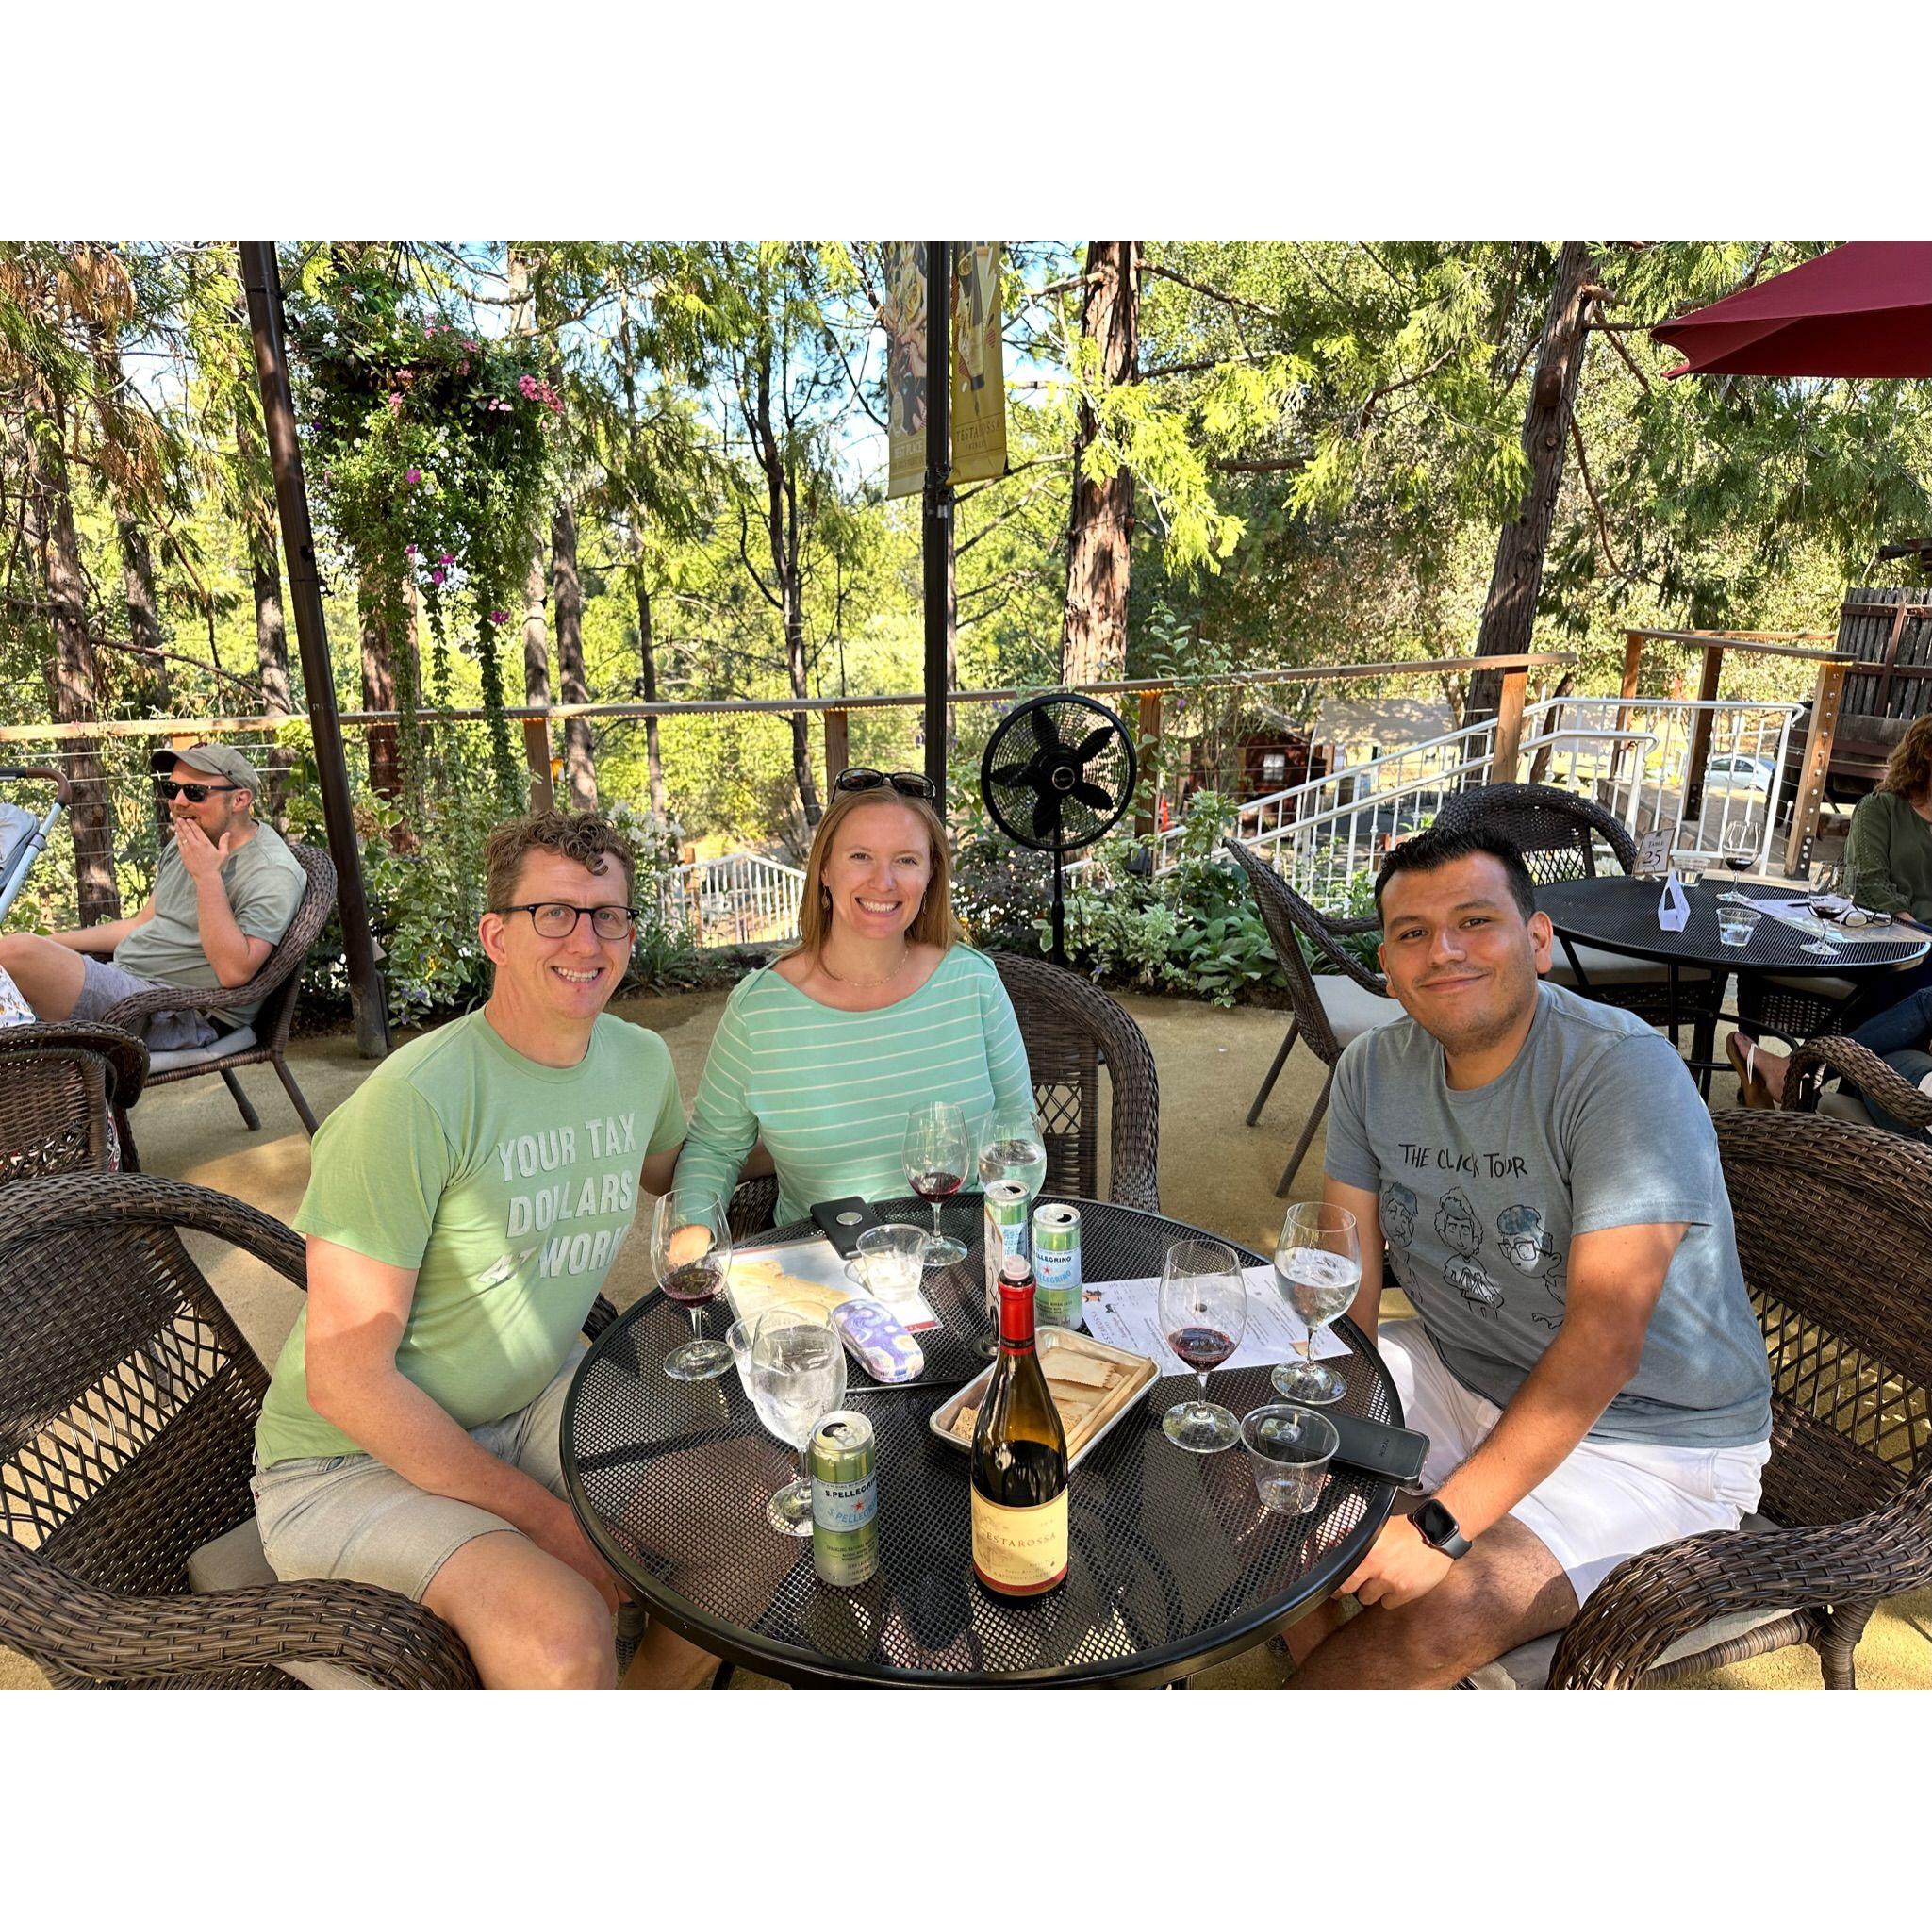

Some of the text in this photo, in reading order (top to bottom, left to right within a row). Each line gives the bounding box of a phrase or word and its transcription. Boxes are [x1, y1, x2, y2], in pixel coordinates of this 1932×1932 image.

[1642, 849, 1663, 865] 25
[498, 1112, 636, 1182] YOUR TAX
[1398, 1143, 1528, 1178] THE CLICK TOUR
[506, 1170, 633, 1239] DOLLARS
[981, 1527, 1056, 1547] TESTAROSSA
